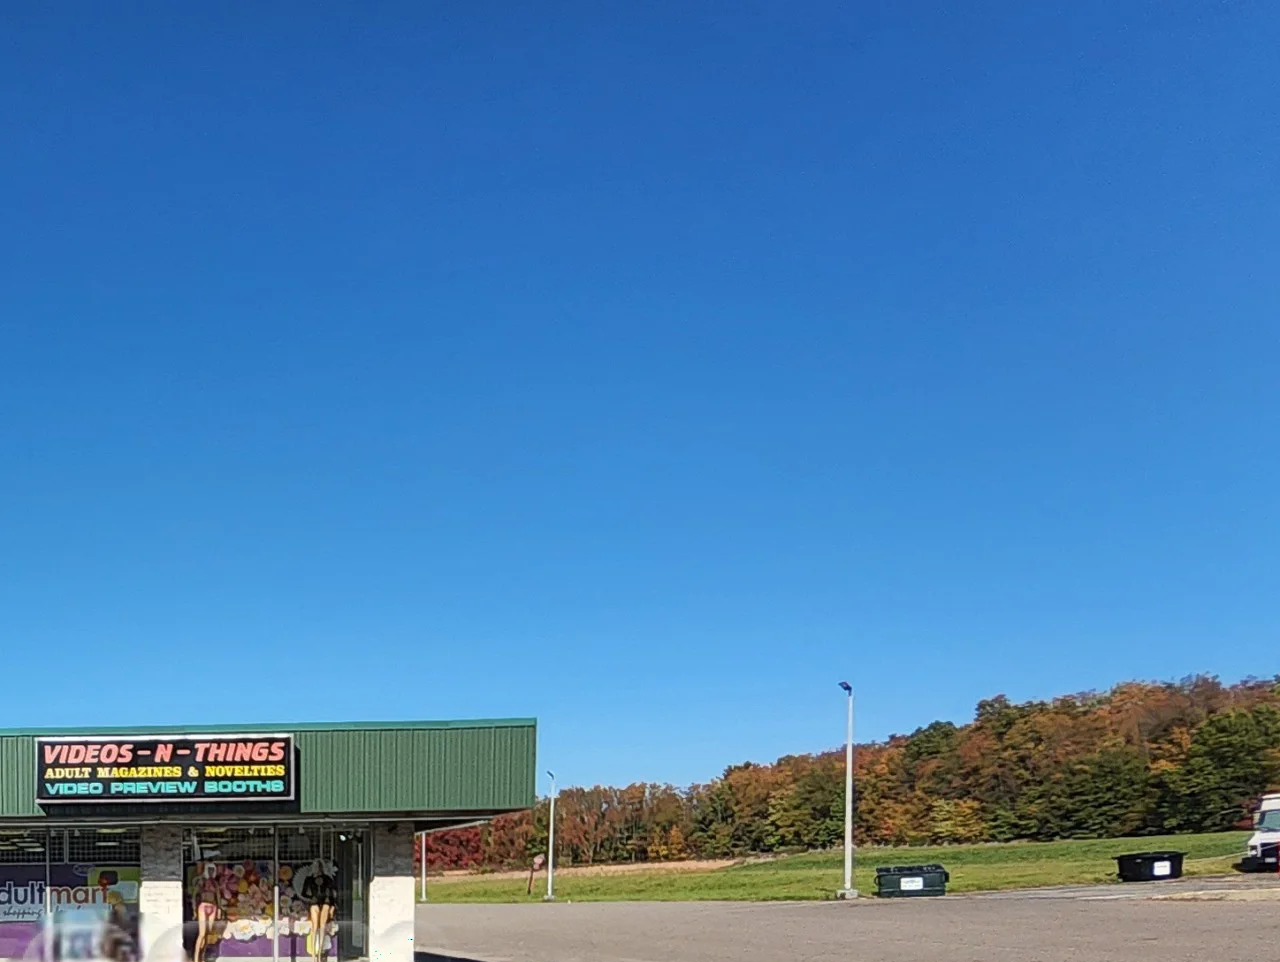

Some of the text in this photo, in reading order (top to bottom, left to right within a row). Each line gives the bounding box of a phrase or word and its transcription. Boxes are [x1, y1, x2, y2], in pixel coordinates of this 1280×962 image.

[44, 765, 286, 779] ADULT MAGAZINES & NOVELTIES
[45, 780, 285, 795] VIDEO PREVIEW BOOTHS
